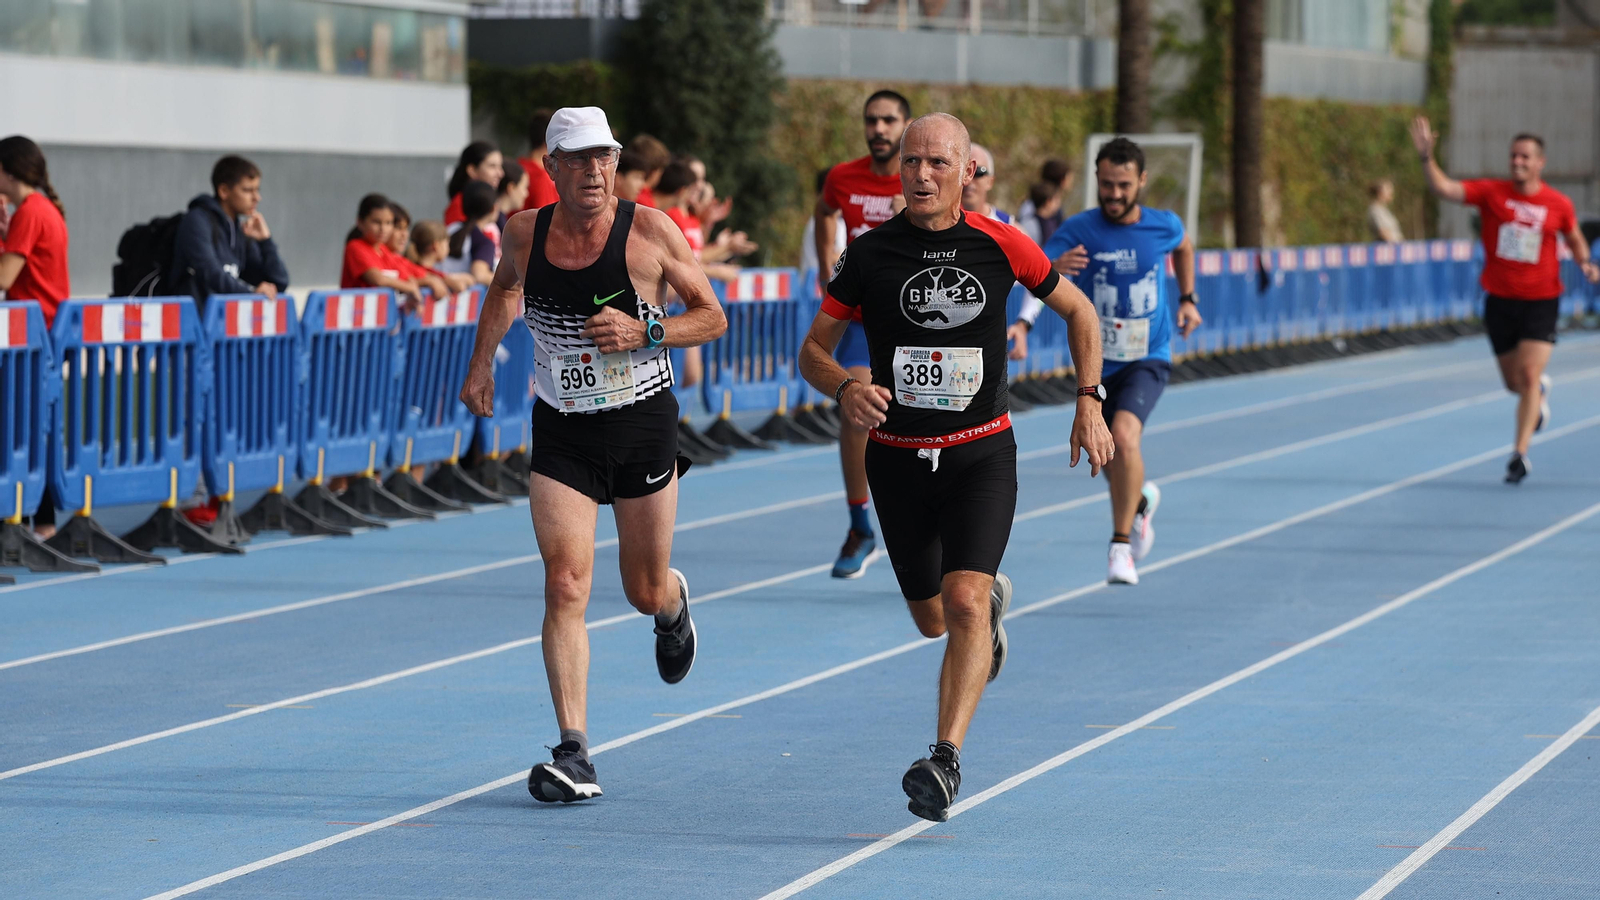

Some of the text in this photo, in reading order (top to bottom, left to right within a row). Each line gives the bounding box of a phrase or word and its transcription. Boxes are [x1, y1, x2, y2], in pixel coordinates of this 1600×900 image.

[923, 248, 957, 259] land
[909, 286, 978, 303] GR322
[560, 366, 596, 390] 596
[903, 364, 942, 386] 389
[876, 420, 1002, 444] NAFARROA EXTREM
